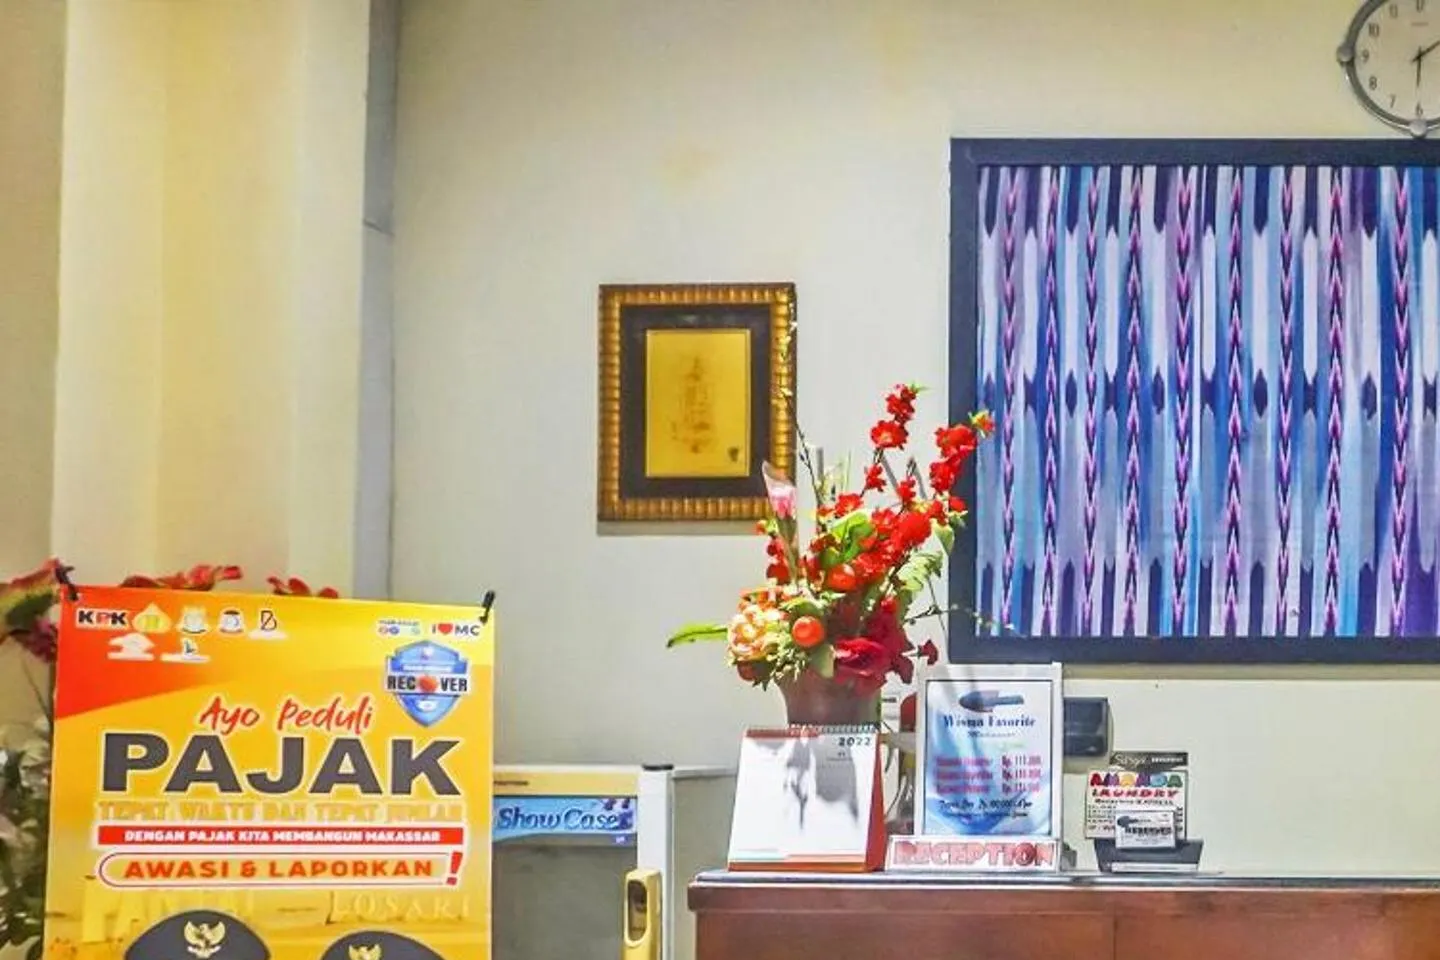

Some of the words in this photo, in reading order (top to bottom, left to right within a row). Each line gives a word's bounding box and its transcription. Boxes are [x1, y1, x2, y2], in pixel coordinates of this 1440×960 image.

[1368, 23, 1380, 38] 10
[1361, 50, 1370, 64] 9
[1368, 76, 1378, 91] 8
[1390, 94, 1397, 109] 7
[1415, 102, 1424, 116] 6
[77, 609, 128, 626] KPK
[200, 696, 260, 735] Ayo
[277, 694, 374, 735] Peduli
[988, 713, 1037, 727] Favorite
[838, 736, 871, 747] 2022
[102, 732, 462, 797] PAJAK
[1090, 772, 1183, 788] AMANDA
[1091, 788, 1179, 798] LAUNDRY
[125, 829, 186, 842] DENGAN
[188, 830, 235, 842] PAJAK
[238, 830, 270, 842] KITA
[272, 830, 363, 842] MEMBANGUN
[366, 830, 441, 843] MAKASSAR
[893, 840, 1055, 867] RECEPTION
[125, 861, 229, 879] AWASI
[240, 860, 260, 878] &
[269, 860, 433, 878] LAPORKAN
